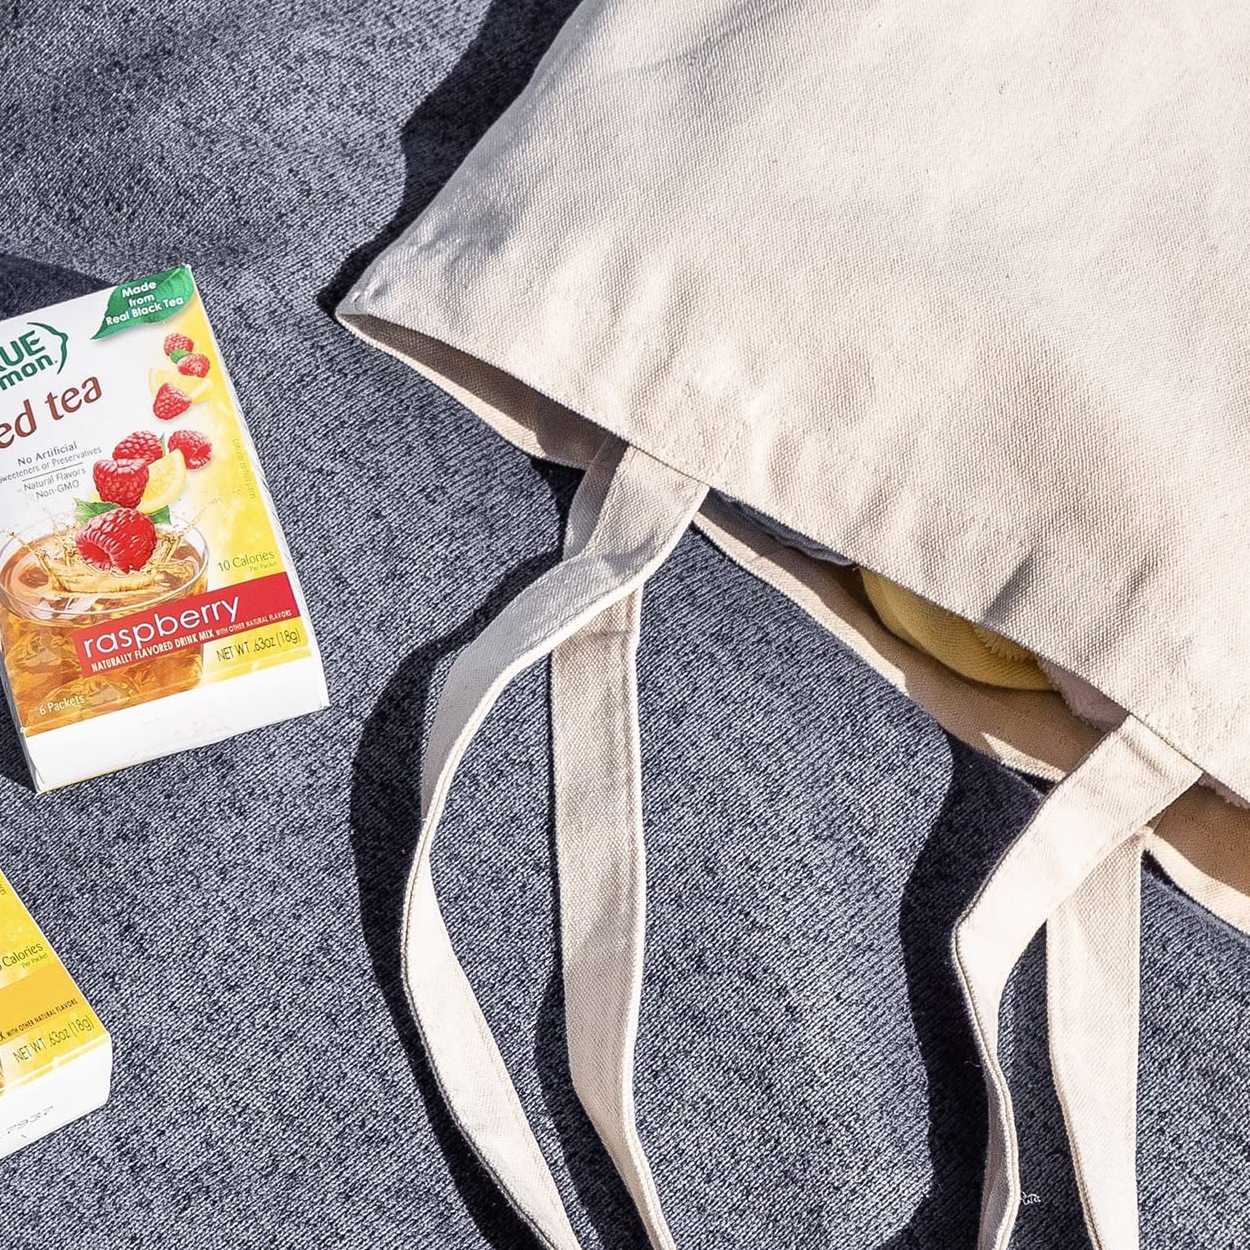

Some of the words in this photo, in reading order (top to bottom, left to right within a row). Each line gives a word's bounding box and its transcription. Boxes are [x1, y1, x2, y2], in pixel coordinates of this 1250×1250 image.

[121, 280, 157, 298] Made
[128, 293, 155, 307] from
[105, 311, 130, 326] Real
[131, 302, 162, 318] Black
[163, 295, 184, 308] Tea
[45, 376, 102, 421] tea
[17, 456, 33, 467] No
[35, 441, 78, 461] Artificial
[41, 462, 50, 471] or
[51, 446, 102, 467] Preservatives
[23, 475, 55, 492] Natural
[55, 468, 86, 484] Flavors
[36, 479, 80, 499] Non-GMO
[217, 560, 231, 572] 10
[232, 551, 275, 569] Calories
[83, 597, 239, 658] raspberry
[91, 651, 132, 672] NATURALLY
[134, 641, 174, 661] FLAVORED
[175, 634, 200, 650] DRINK
[199, 629, 215, 644] MIX
[215, 627, 228, 636] WITH
[228, 622, 245, 633] OTHER
[245, 616, 269, 629] NATURAL
[269, 609, 292, 622] FLAVORS
[216, 646, 234, 662] NET
[234, 642, 251, 657] WT
[276, 629, 301, 649] (18g)
[39, 703, 47, 715] 6
[47, 693, 85, 713] Packets
[1, 942, 44, 968] Calories
[22, 961, 31, 969] Per
[30, 953, 49, 965] Packet
[6, 1028, 18, 1037] WITH
[18, 1021, 35, 1033] OTHER
[34, 1010, 57, 1025] NATURAL
[55, 999, 79, 1015] FLAVORS
[12, 1044, 30, 1062] NET
[29, 1038, 47, 1055] WT
[70, 1015, 96, 1040] (18g)
